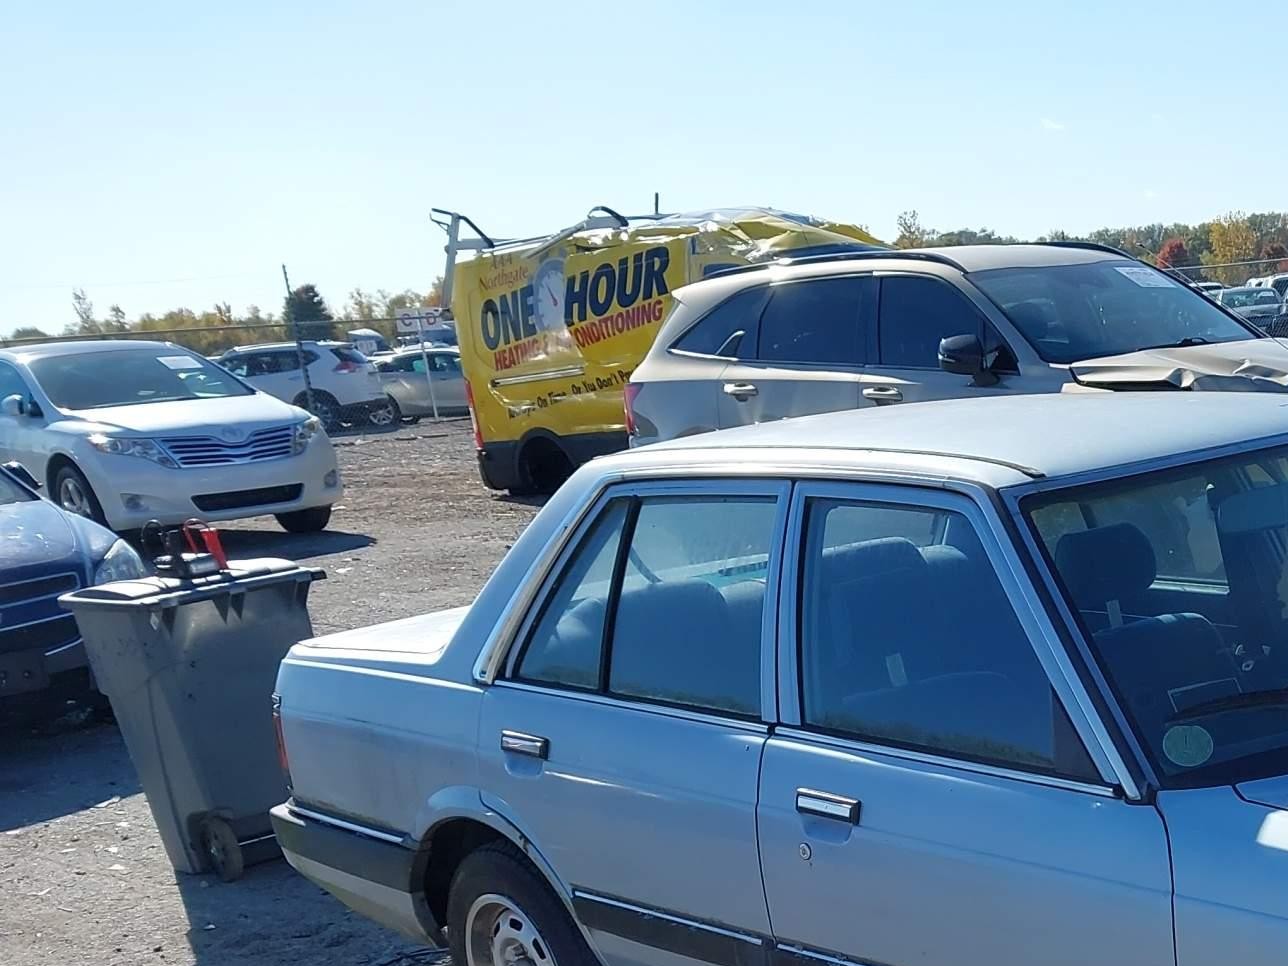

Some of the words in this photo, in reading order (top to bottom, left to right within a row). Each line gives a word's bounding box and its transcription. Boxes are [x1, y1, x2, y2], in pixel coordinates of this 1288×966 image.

[479, 264, 529, 291] Northgate
[481, 283, 538, 350] ONE
[564, 246, 669, 327] HOUR
[494, 336, 539, 371] HEATING
[569, 299, 663, 350] ONDITIONING
